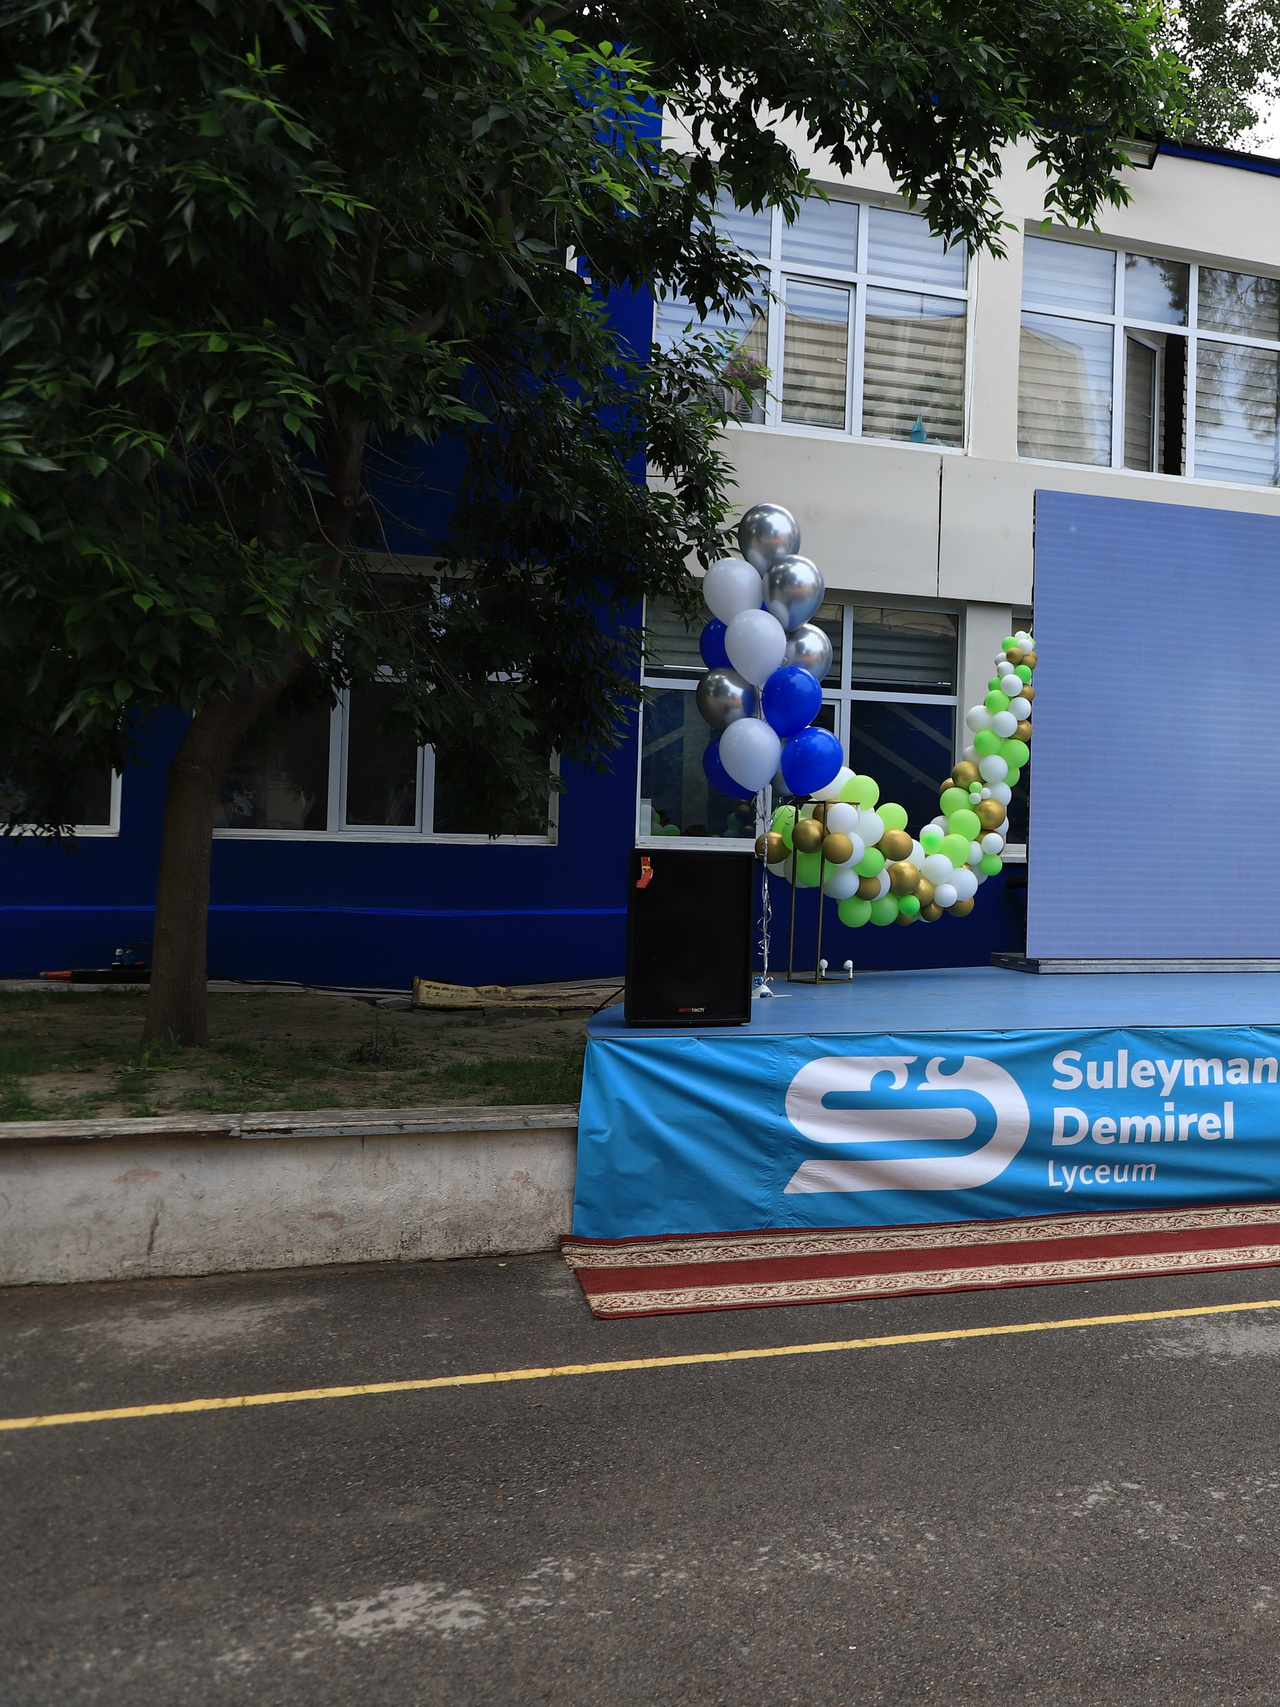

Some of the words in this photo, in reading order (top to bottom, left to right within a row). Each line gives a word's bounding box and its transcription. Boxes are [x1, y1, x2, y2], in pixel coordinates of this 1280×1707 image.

[1051, 1049, 1279, 1097] Suleyman
[1051, 1101, 1234, 1146] Demirel
[1047, 1159, 1157, 1193] Lyceum
